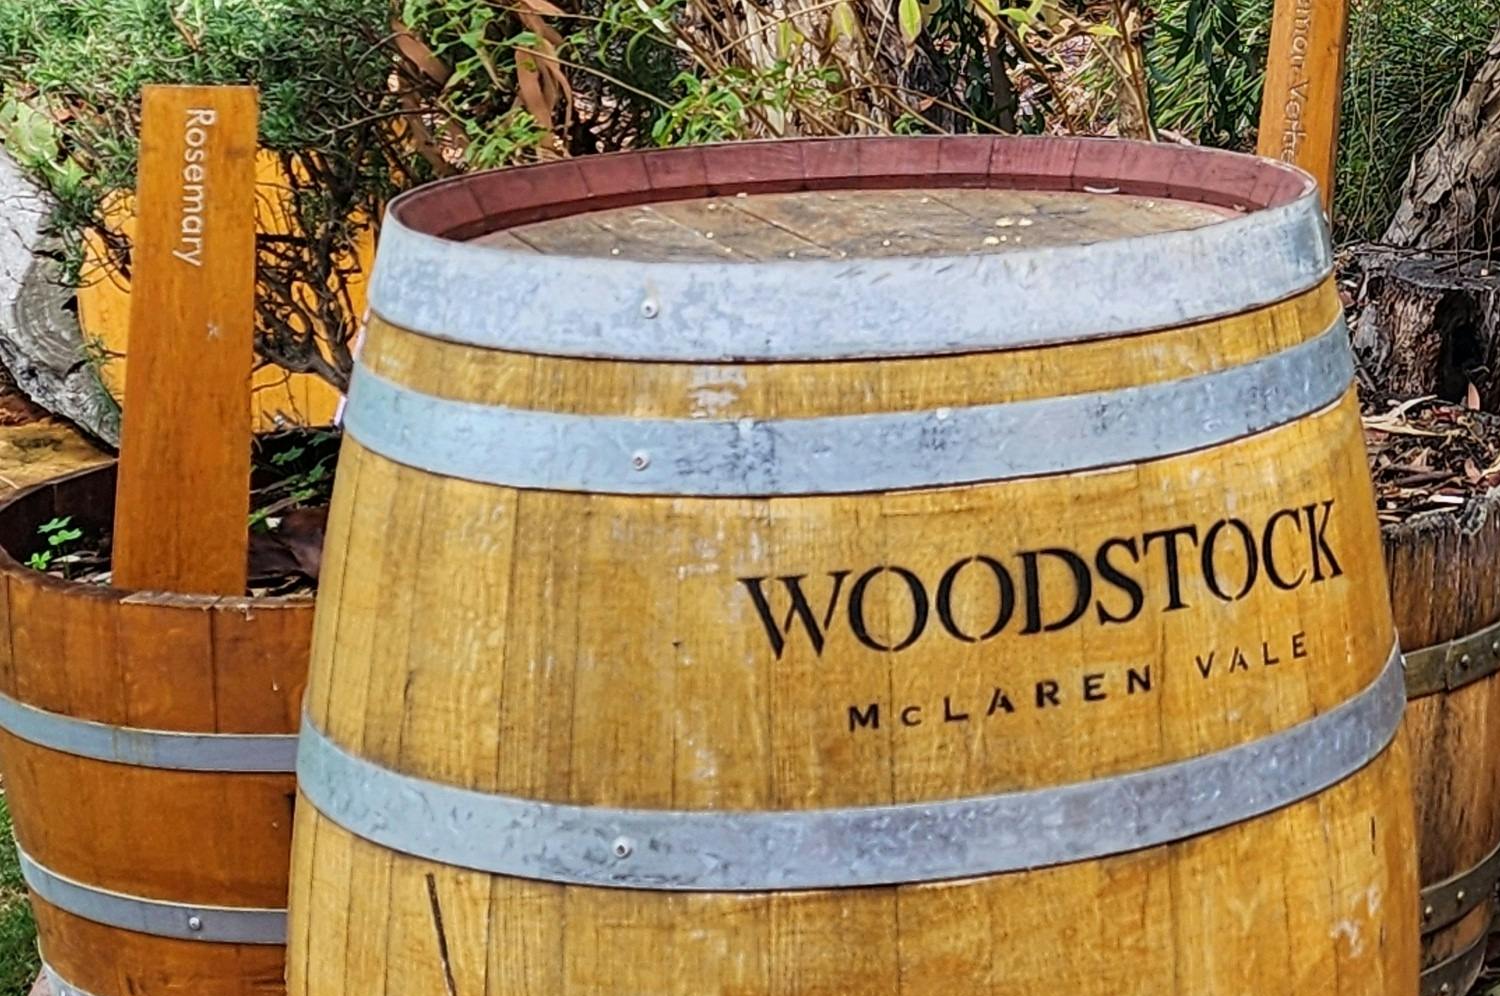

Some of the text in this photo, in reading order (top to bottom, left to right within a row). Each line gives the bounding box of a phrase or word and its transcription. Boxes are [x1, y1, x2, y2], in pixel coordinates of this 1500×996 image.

[171, 108, 217, 267] Rosemary
[738, 499, 1344, 661] WOODSTOCK
[848, 631, 1308, 732] McLAREN VALE
